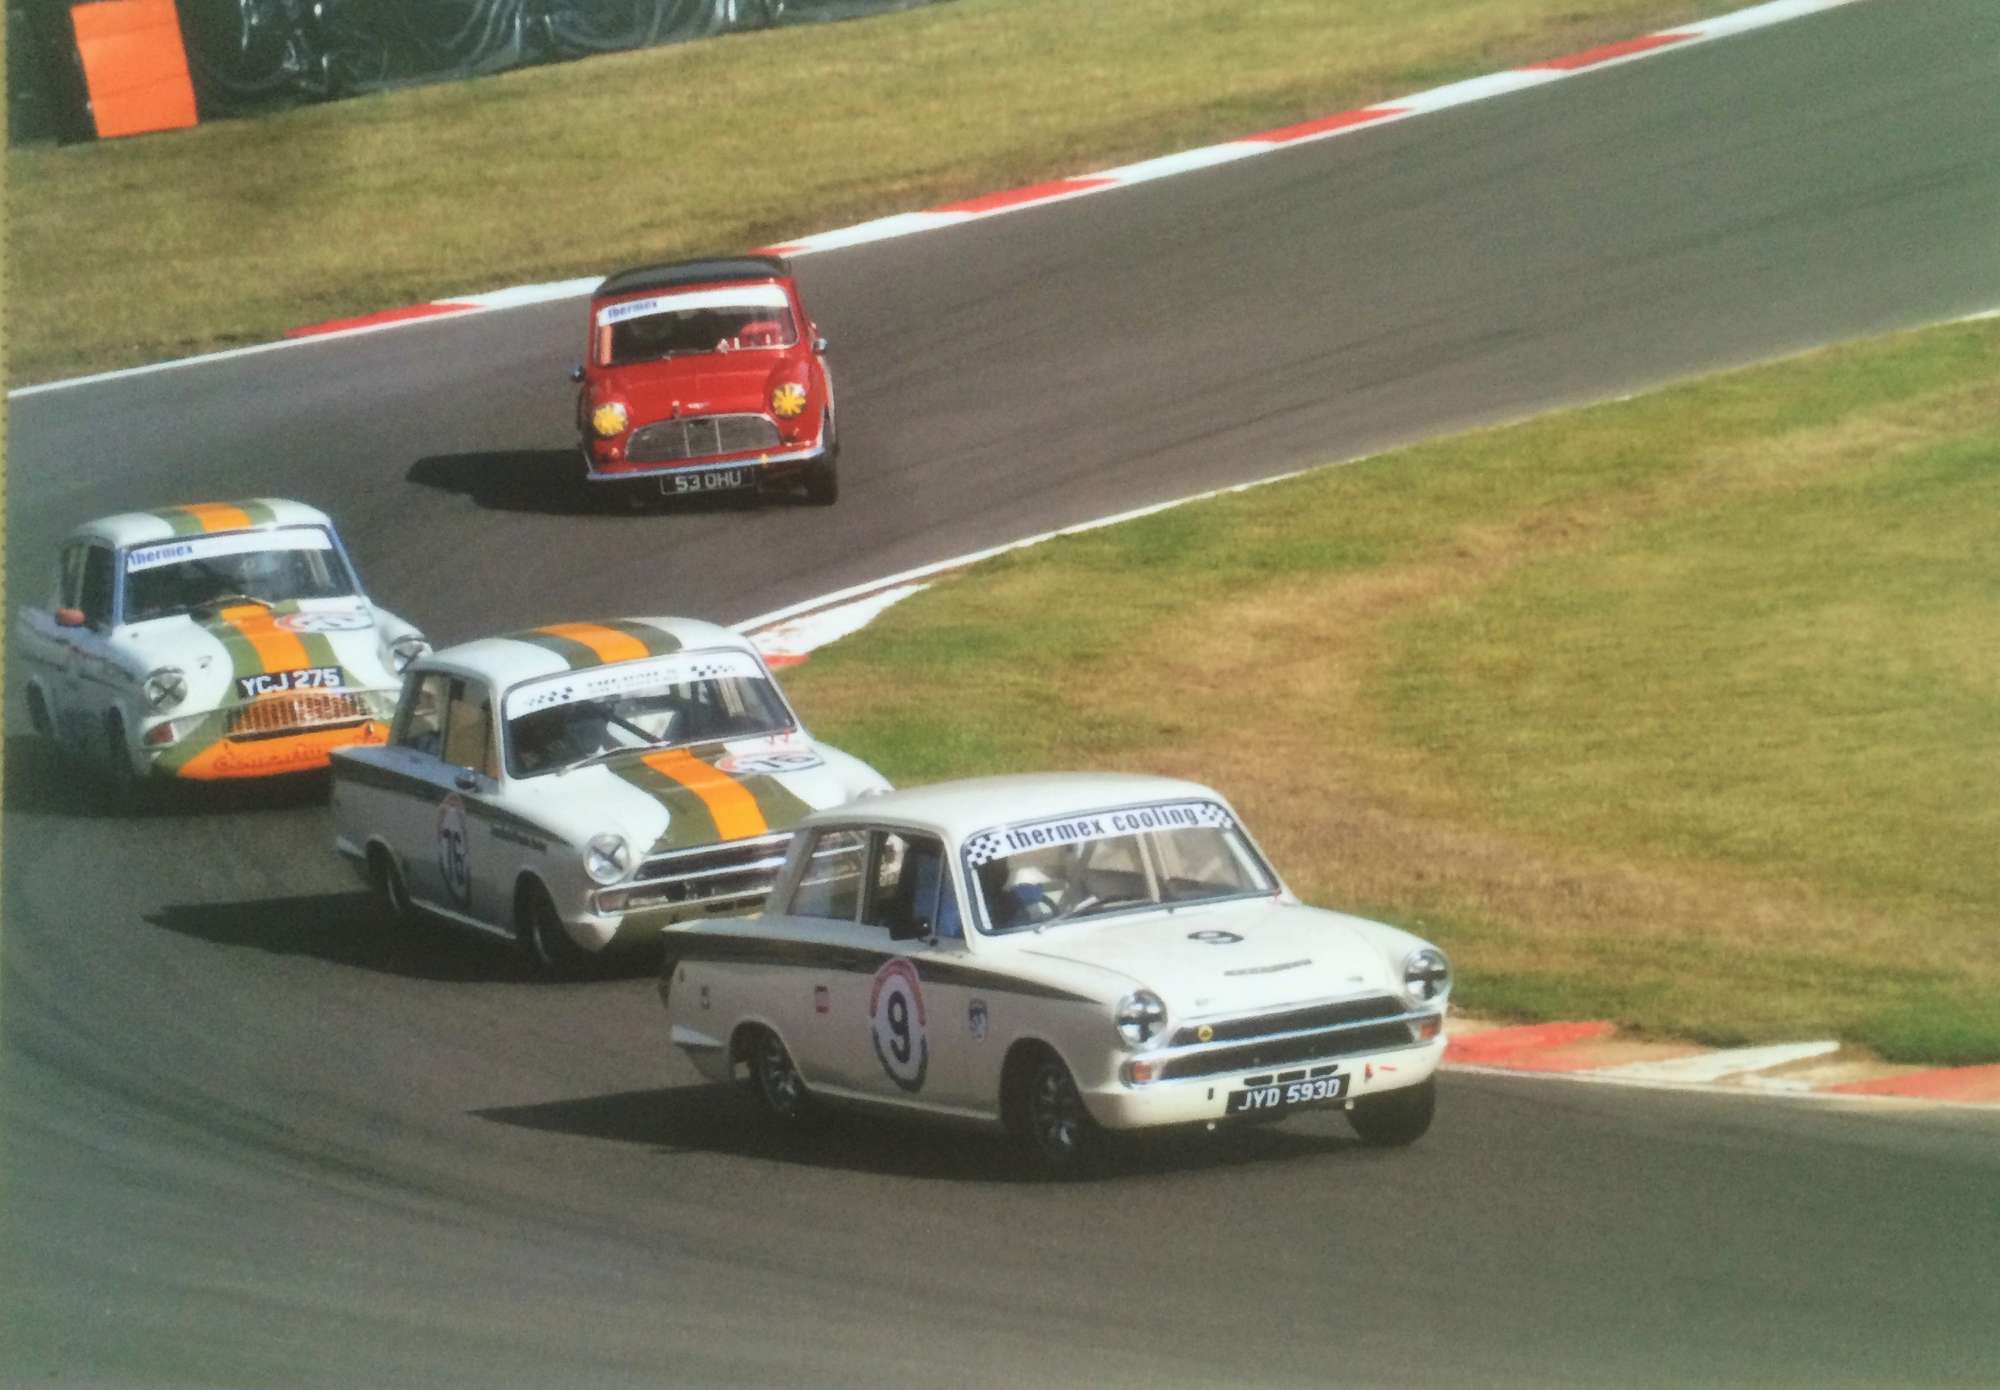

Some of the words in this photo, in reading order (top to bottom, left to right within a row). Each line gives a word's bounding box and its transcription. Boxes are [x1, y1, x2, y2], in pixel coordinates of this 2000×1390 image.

[675, 475, 701, 493] 53
[241, 673, 289, 697] YCJ
[292, 668, 338, 688] 275
[1006, 818, 1105, 850] thermex
[1112, 806, 1200, 832] cooling
[887, 990, 912, 1064] 9
[1238, 1088, 1281, 1111] JYD
[1286, 1079, 1340, 1104] 593D
